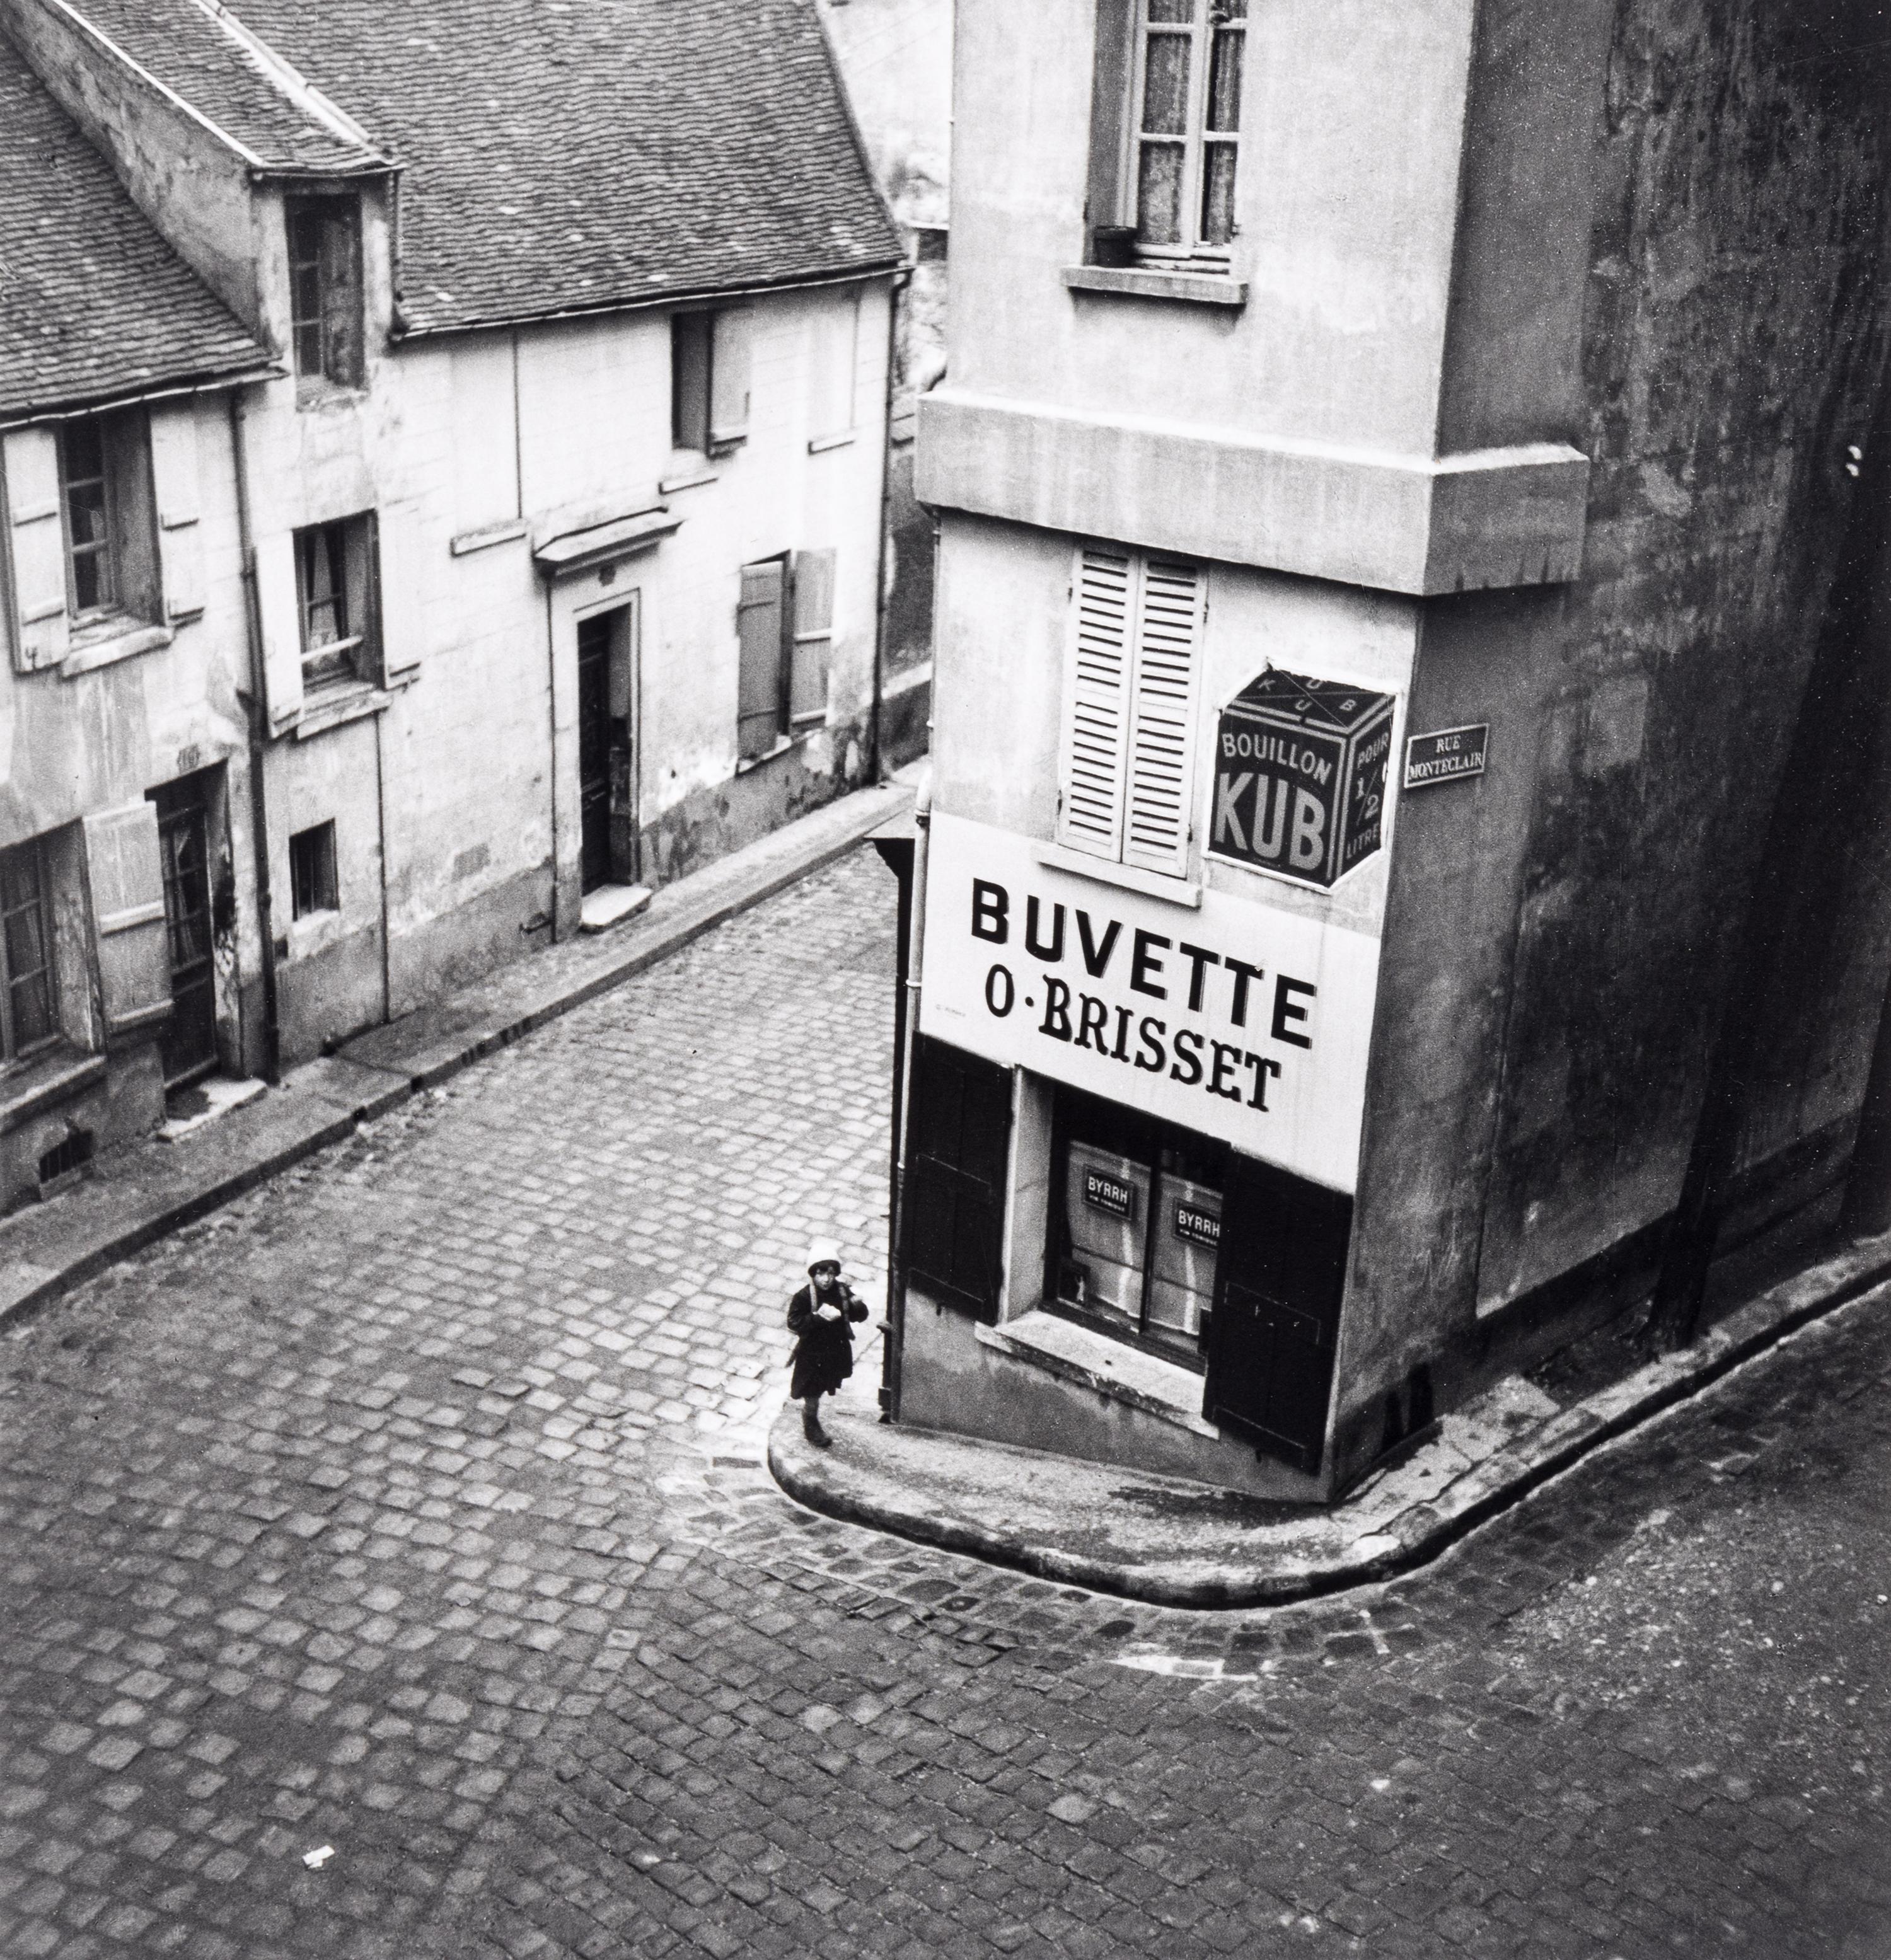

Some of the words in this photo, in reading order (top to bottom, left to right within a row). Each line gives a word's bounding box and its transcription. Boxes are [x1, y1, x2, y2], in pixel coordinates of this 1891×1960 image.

[1222, 732, 1332, 785] BOUILLON
[1357, 732, 1389, 770] POUR
[1436, 735, 1461, 753] RUE
[1214, 772, 1326, 870] KUB
[1346, 822, 1380, 860] LITRE
[971, 878, 1317, 1049] BUVETTE
[1088, 1176, 1128, 1204] BYRRH
[1178, 1209, 1220, 1237] BYRRH
